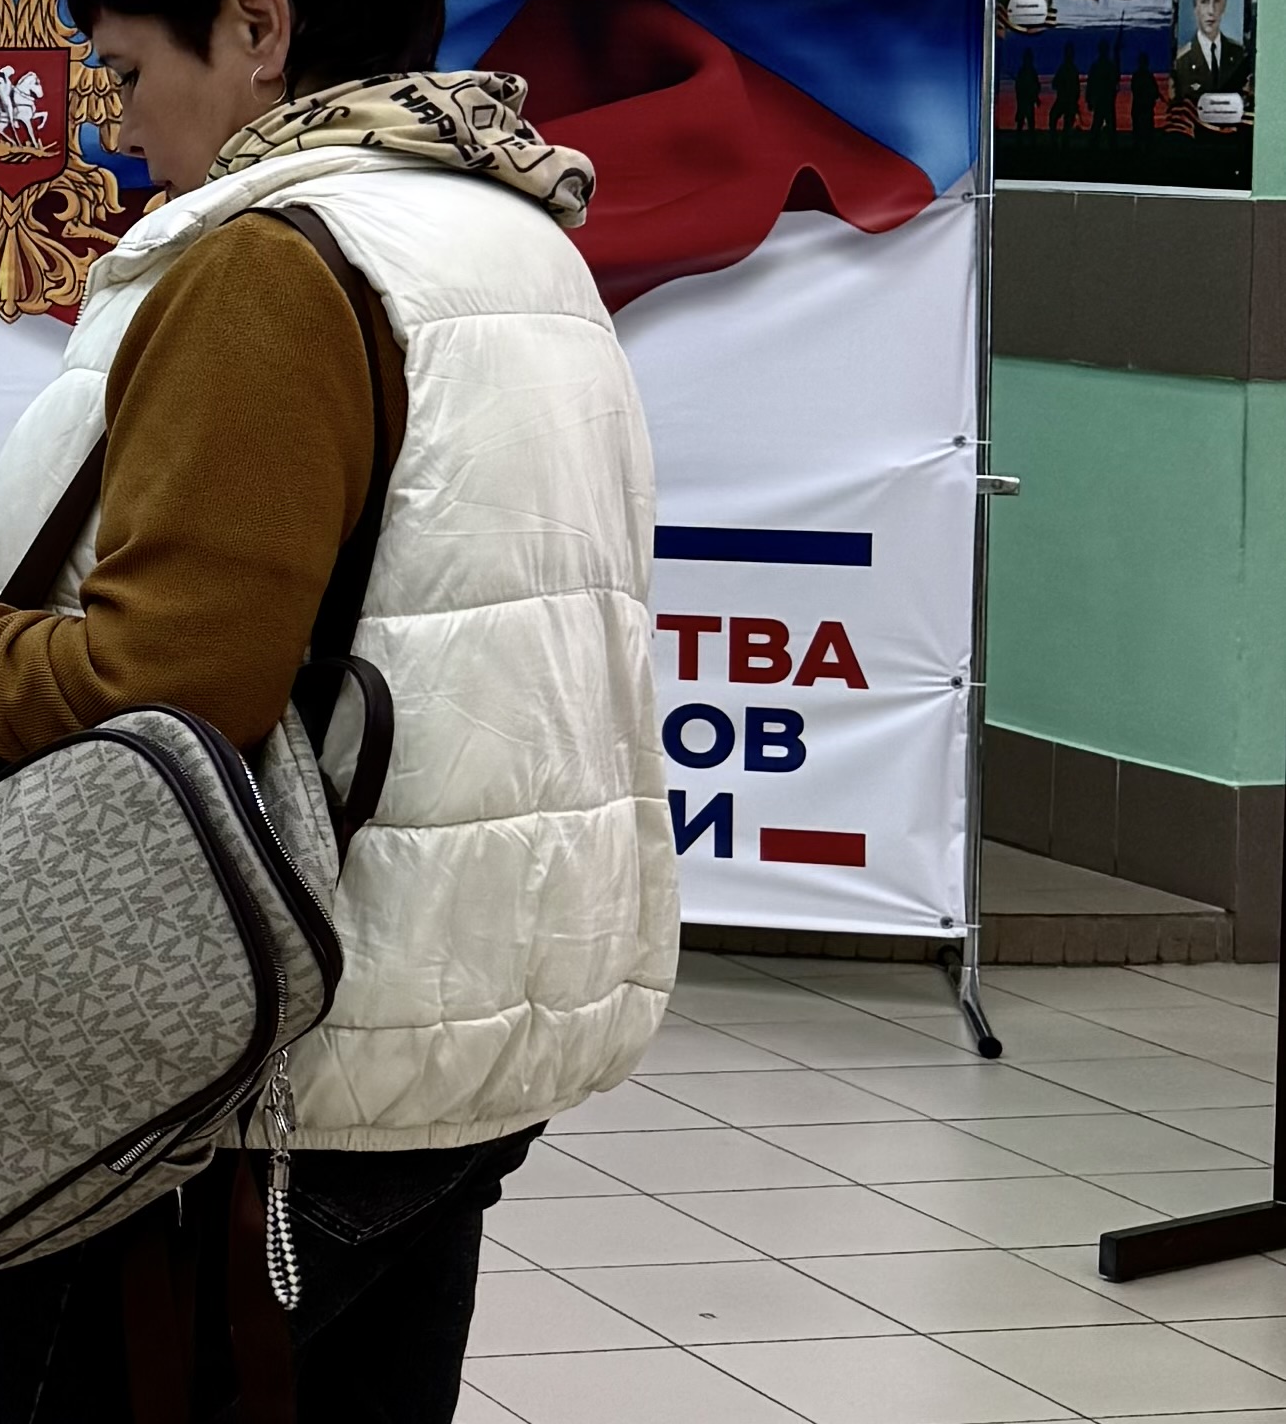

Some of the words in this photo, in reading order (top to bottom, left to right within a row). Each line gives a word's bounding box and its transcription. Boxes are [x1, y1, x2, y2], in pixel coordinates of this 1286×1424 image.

[656, 613, 870, 690] ТВА
[661, 702, 807, 773] ОВ
[668, 789, 733, 859] И
